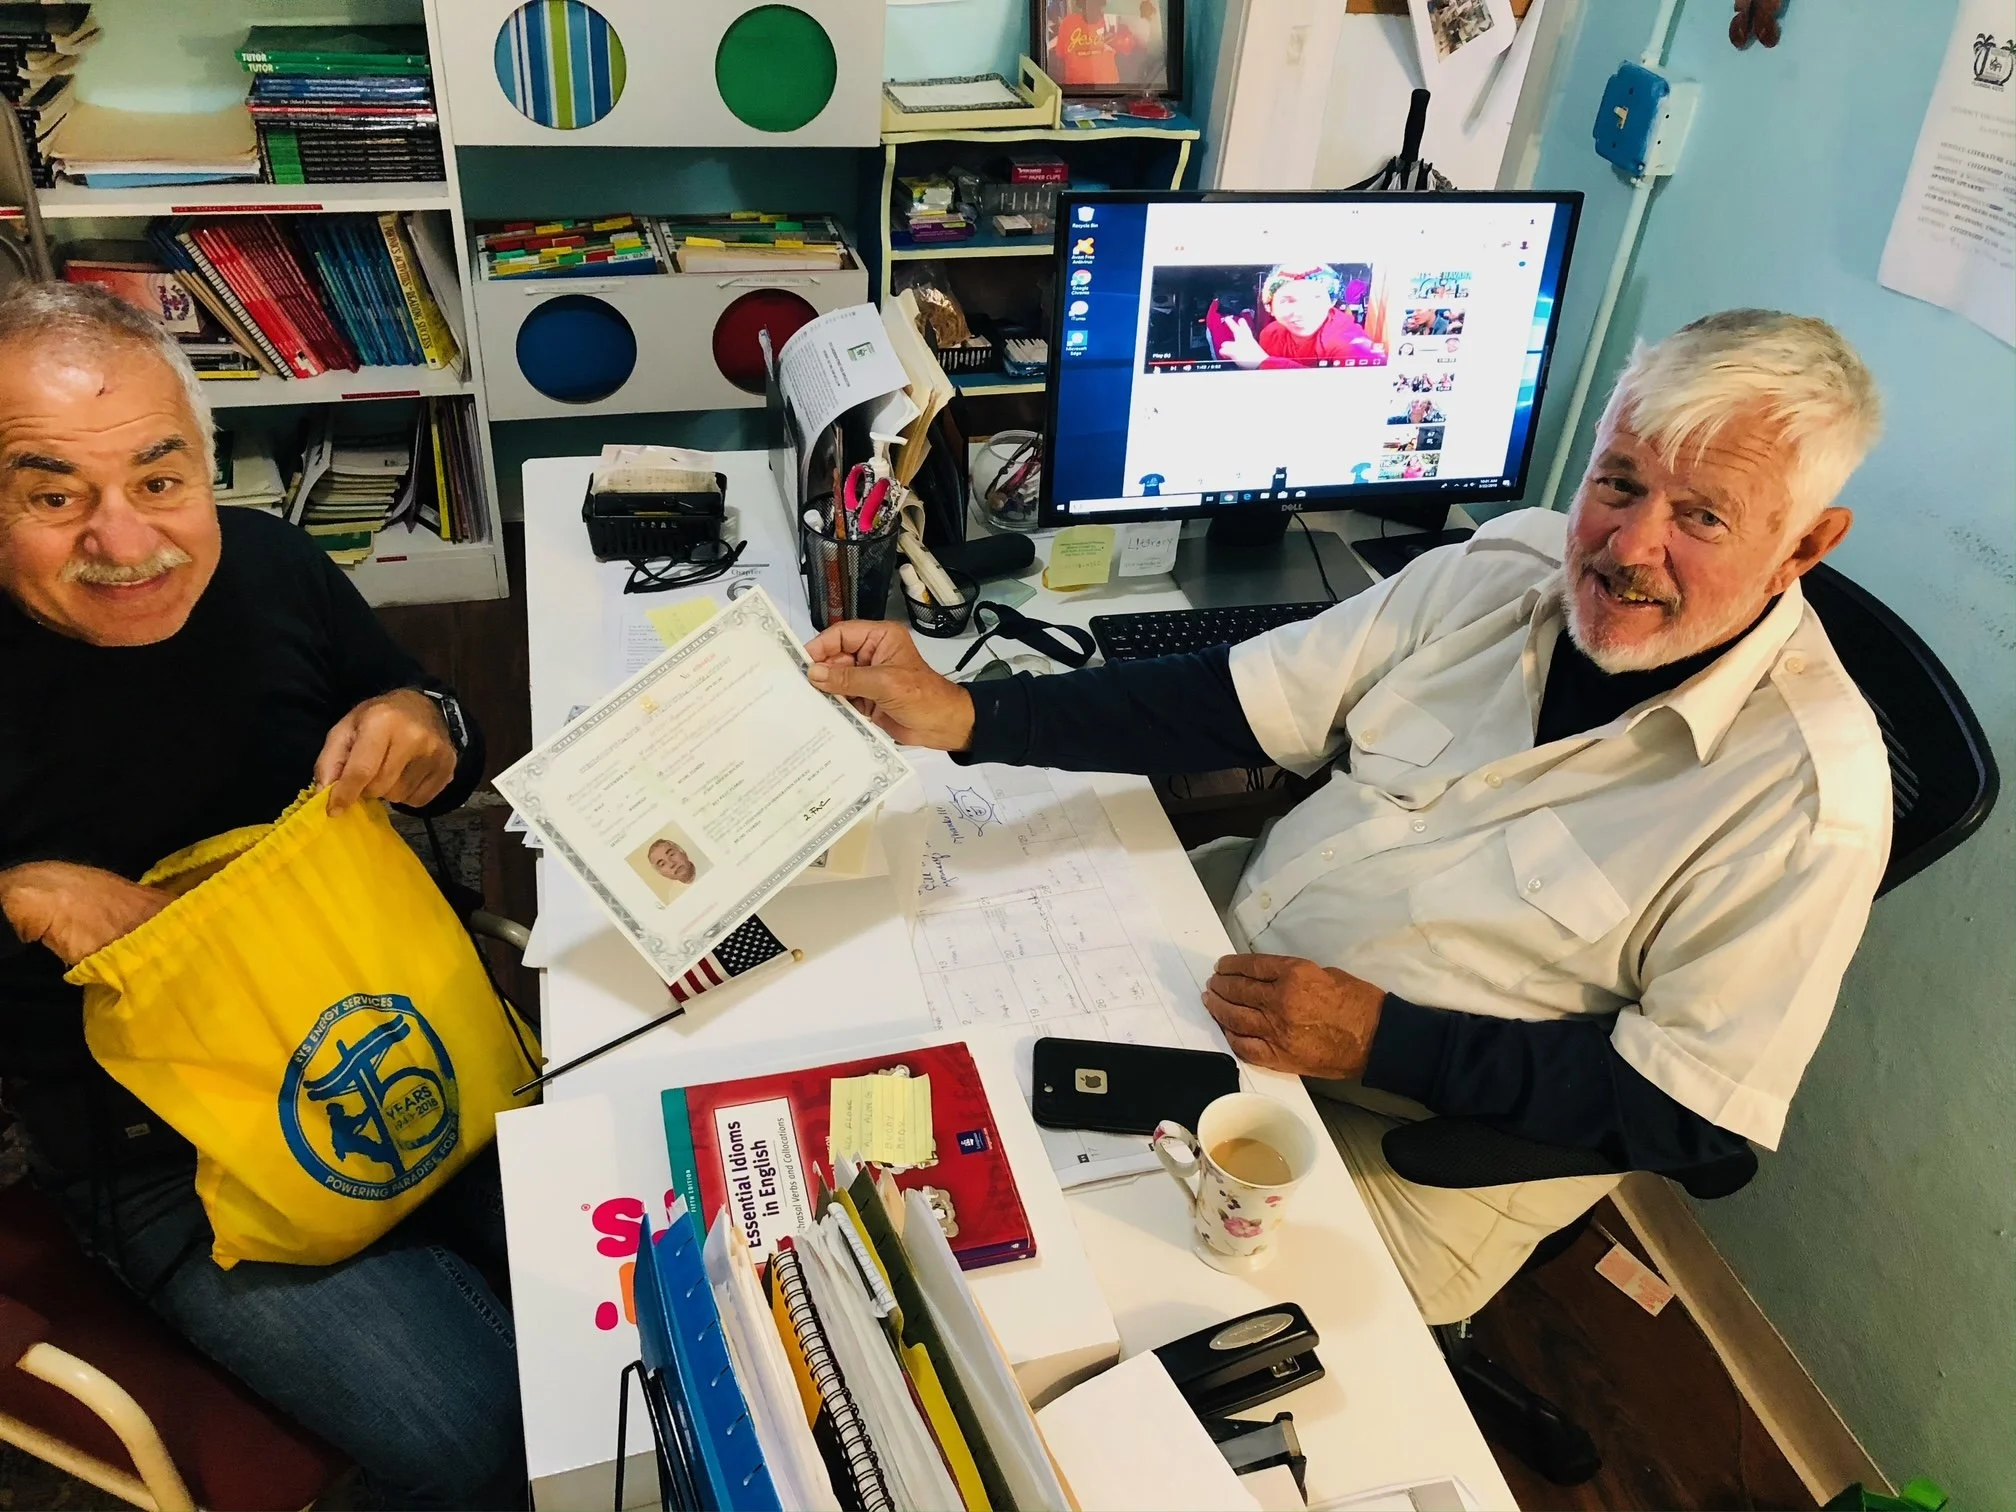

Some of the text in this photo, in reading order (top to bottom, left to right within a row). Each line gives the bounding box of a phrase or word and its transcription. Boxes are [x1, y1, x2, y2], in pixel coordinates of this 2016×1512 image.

[242, 53, 268, 62] TUTOR
[248, 63, 274, 73] TUTOR
[394, 253, 412, 287] ACTIVITIES
[405, 290, 423, 324] READING
[416, 321, 432, 349] SUCCESS
[1281, 503, 1303, 512] DELL
[731, 568, 763, 576] Chapter
[310, 1006, 340, 1042] ENERGY
[343, 996, 393, 1012] SERVICES
[1030, 1008, 1039, 1018] 19
[1097, 999, 1107, 1009] 26
[386, 1085, 433, 1121] YEARS
[326, 1175, 389, 1198] POWERING
[439, 1131, 457, 1159] FOR
[728, 1120, 762, 1249] Essential Idioms
[750, 1139, 780, 1217] in English
[777, 1117, 806, 1230] hrasal Verbs and Collocations
[686, 1169, 697, 1213] FIFTH EDITION
